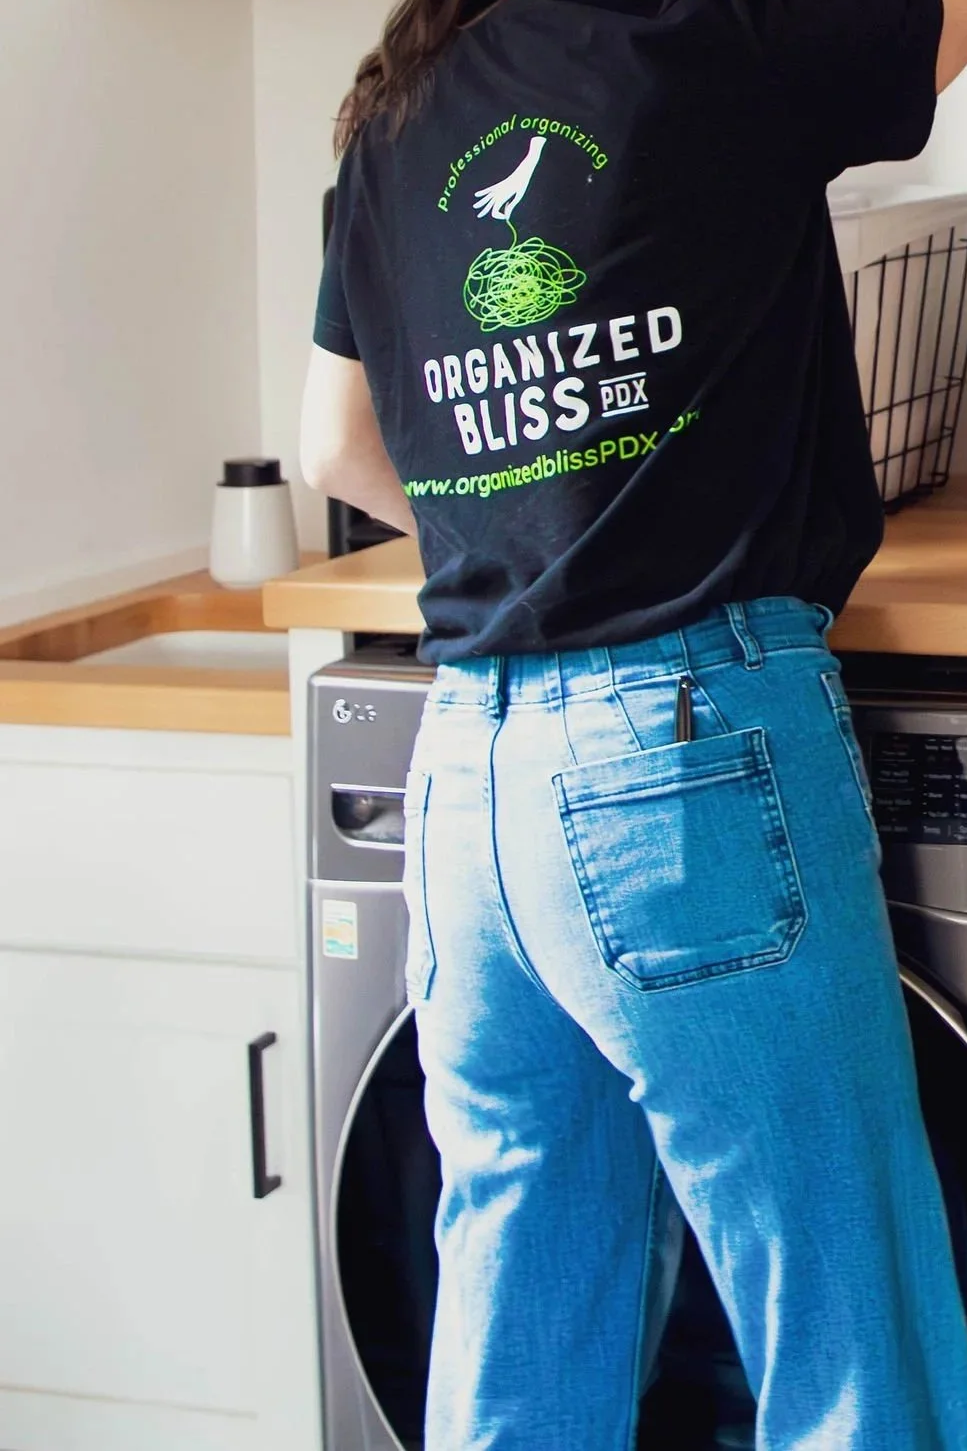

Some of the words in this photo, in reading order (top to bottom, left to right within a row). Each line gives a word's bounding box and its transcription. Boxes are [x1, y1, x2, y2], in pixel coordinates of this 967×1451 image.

[437, 113, 517, 213] professional
[519, 117, 609, 170] organizing
[423, 306, 683, 404] ORGANIZED
[600, 378, 649, 411] PDX
[453, 376, 590, 455] BLISS
